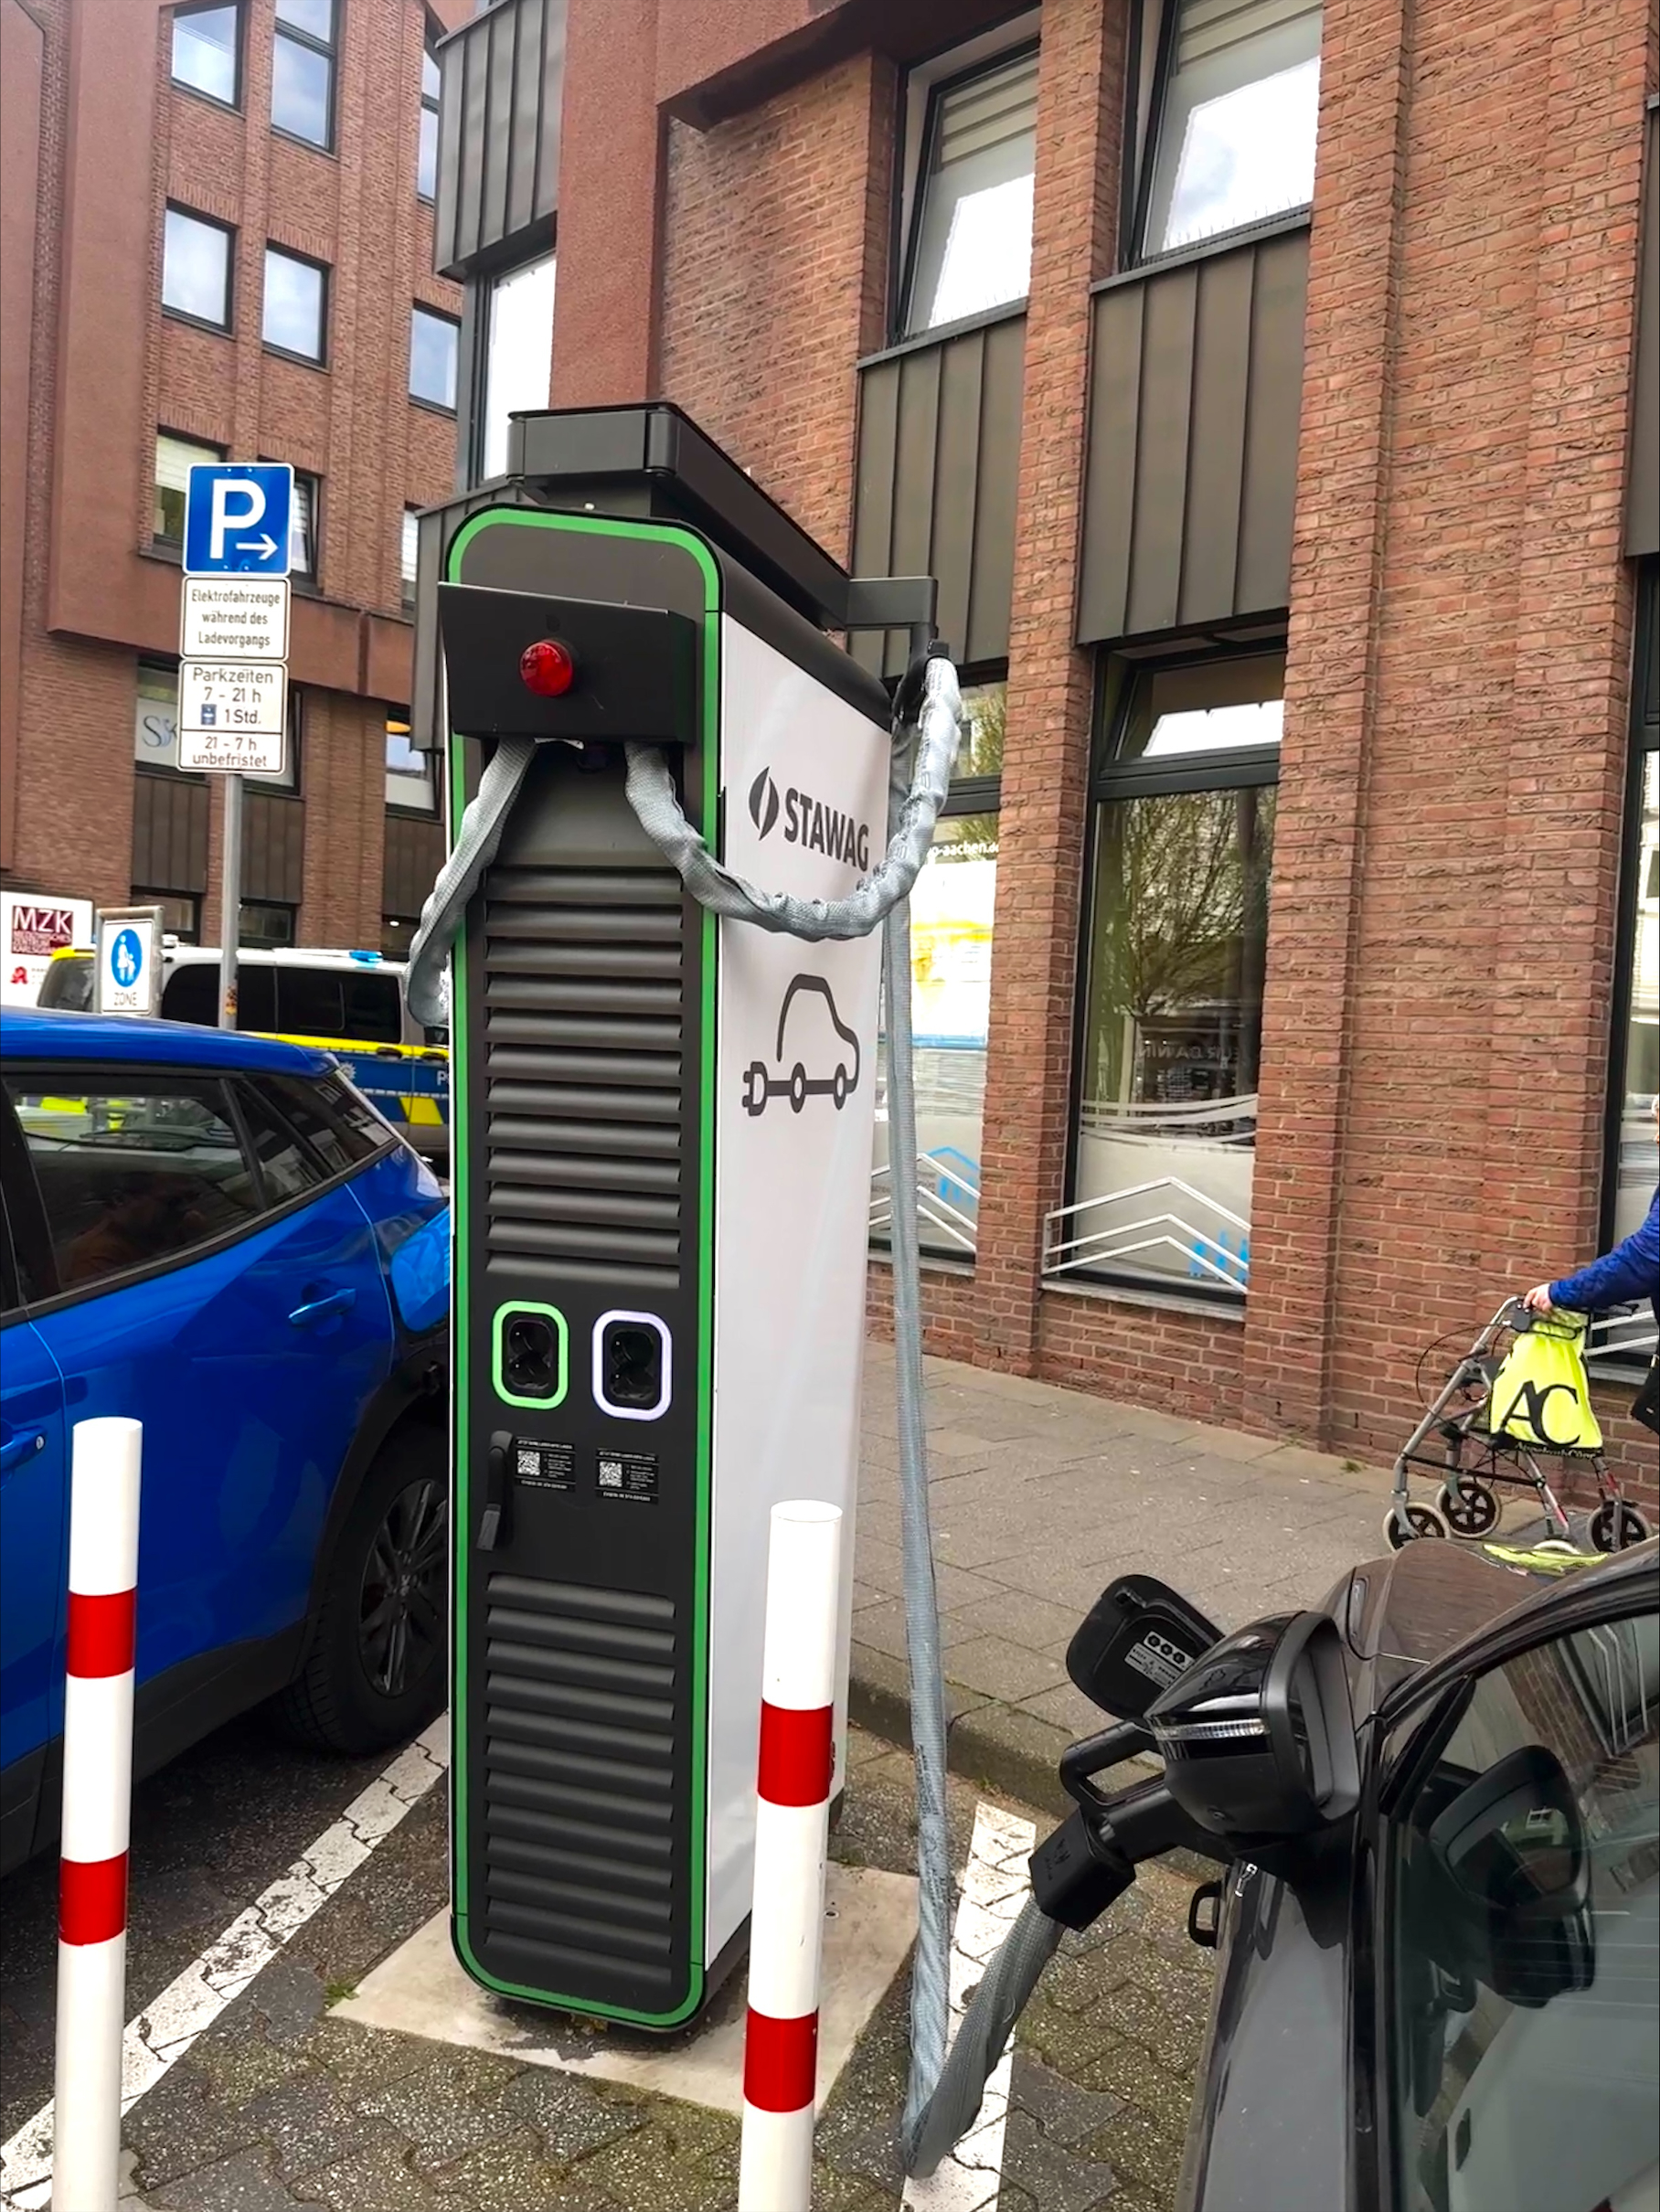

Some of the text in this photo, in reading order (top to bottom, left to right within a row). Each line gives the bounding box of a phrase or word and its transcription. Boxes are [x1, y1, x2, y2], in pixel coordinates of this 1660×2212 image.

[209, 478, 266, 559] P
[191, 589, 281, 608] Elektrofahrzeuge
[202, 610, 269, 625] während des
[198, 631, 271, 649] Ladevorgangs
[193, 666, 273, 684] Parkzeiten
[204, 686, 213, 701] 7
[232, 687, 246, 702] 21
[252, 688, 261, 703] h
[233, 708, 261, 725] Std.
[205, 736, 218, 750] 21
[235, 737, 243, 750] 7
[249, 738, 257, 750] h
[193, 751, 267, 767] unbefristet
[784, 787, 869, 872] STAWAG
[13, 906, 71, 933] MZK
[114, 992, 137, 1006] ZONE
[437, 1070, 449, 1086] P
[1499, 1380, 1580, 1448] AC
